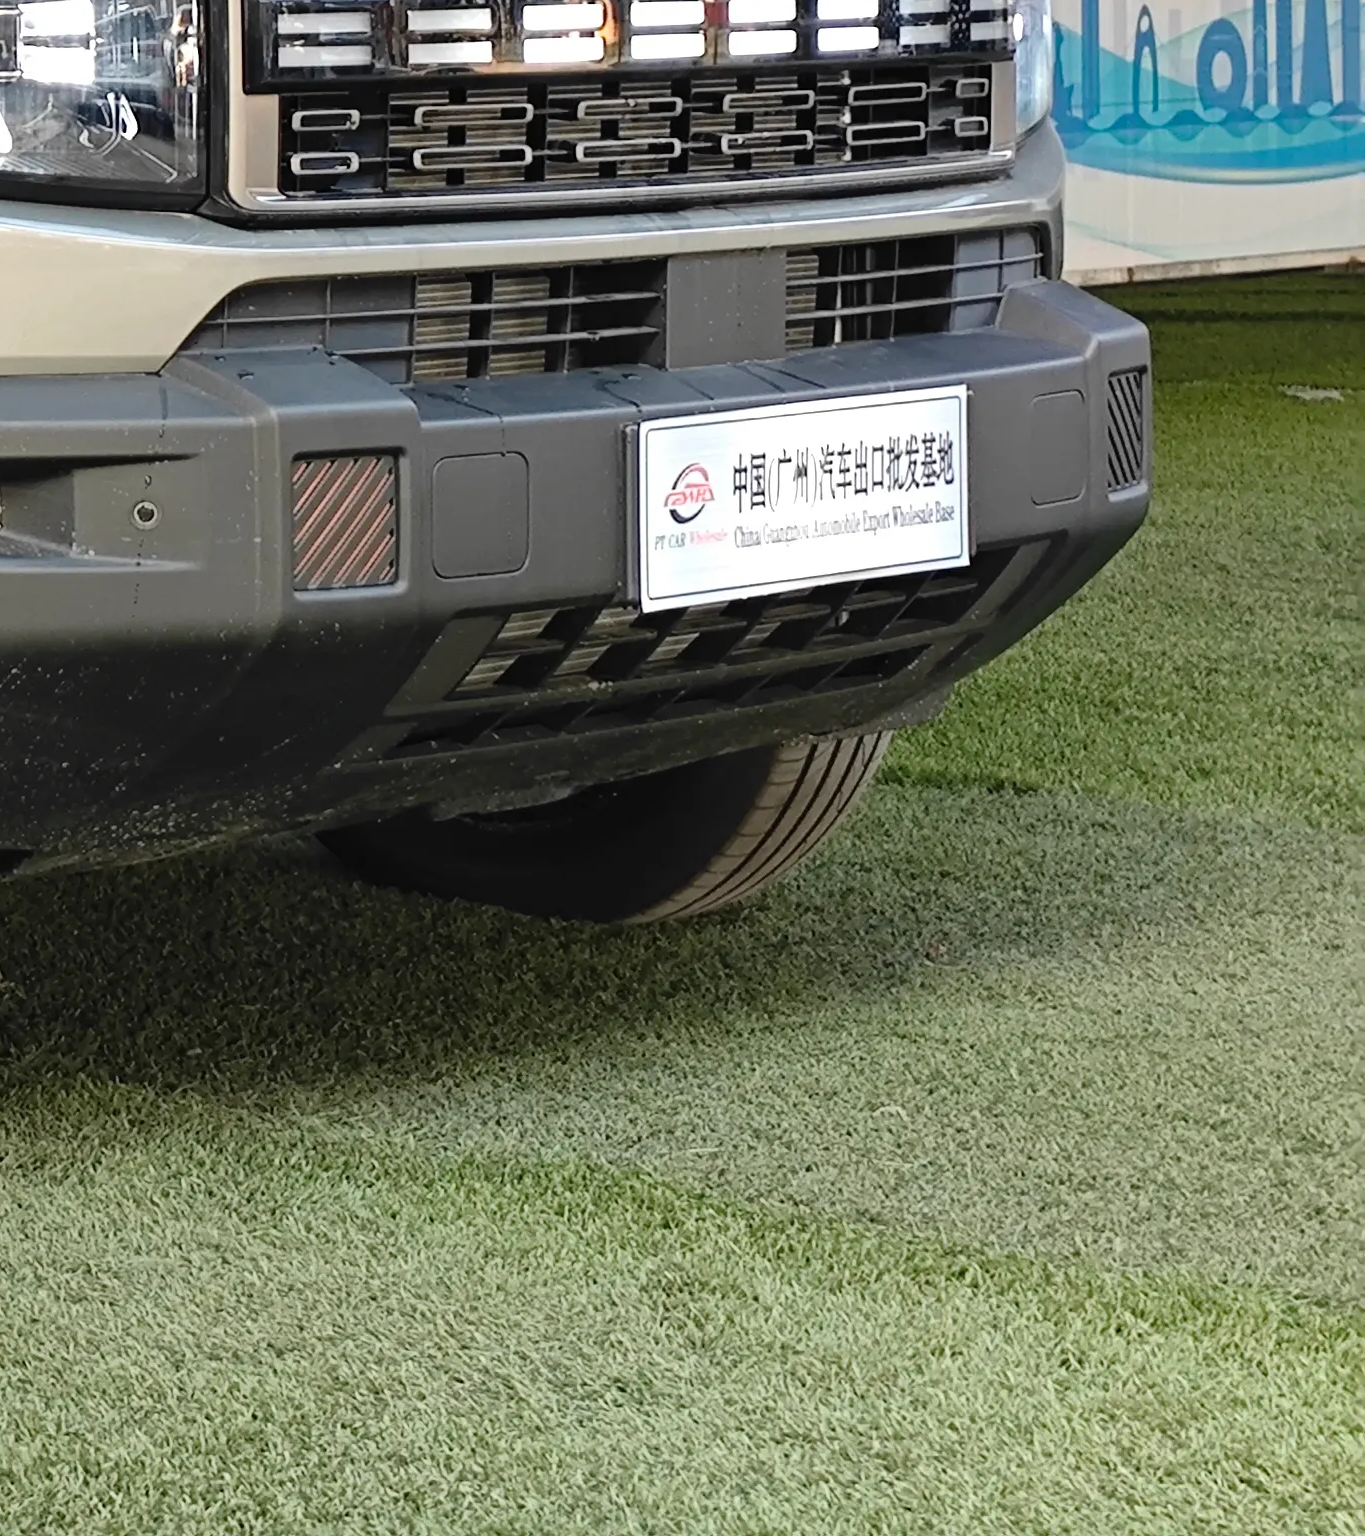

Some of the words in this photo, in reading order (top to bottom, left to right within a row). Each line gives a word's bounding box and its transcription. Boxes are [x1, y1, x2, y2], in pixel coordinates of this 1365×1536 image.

[733, 430, 955, 515] 中国(广州)汽车出口批发基地
